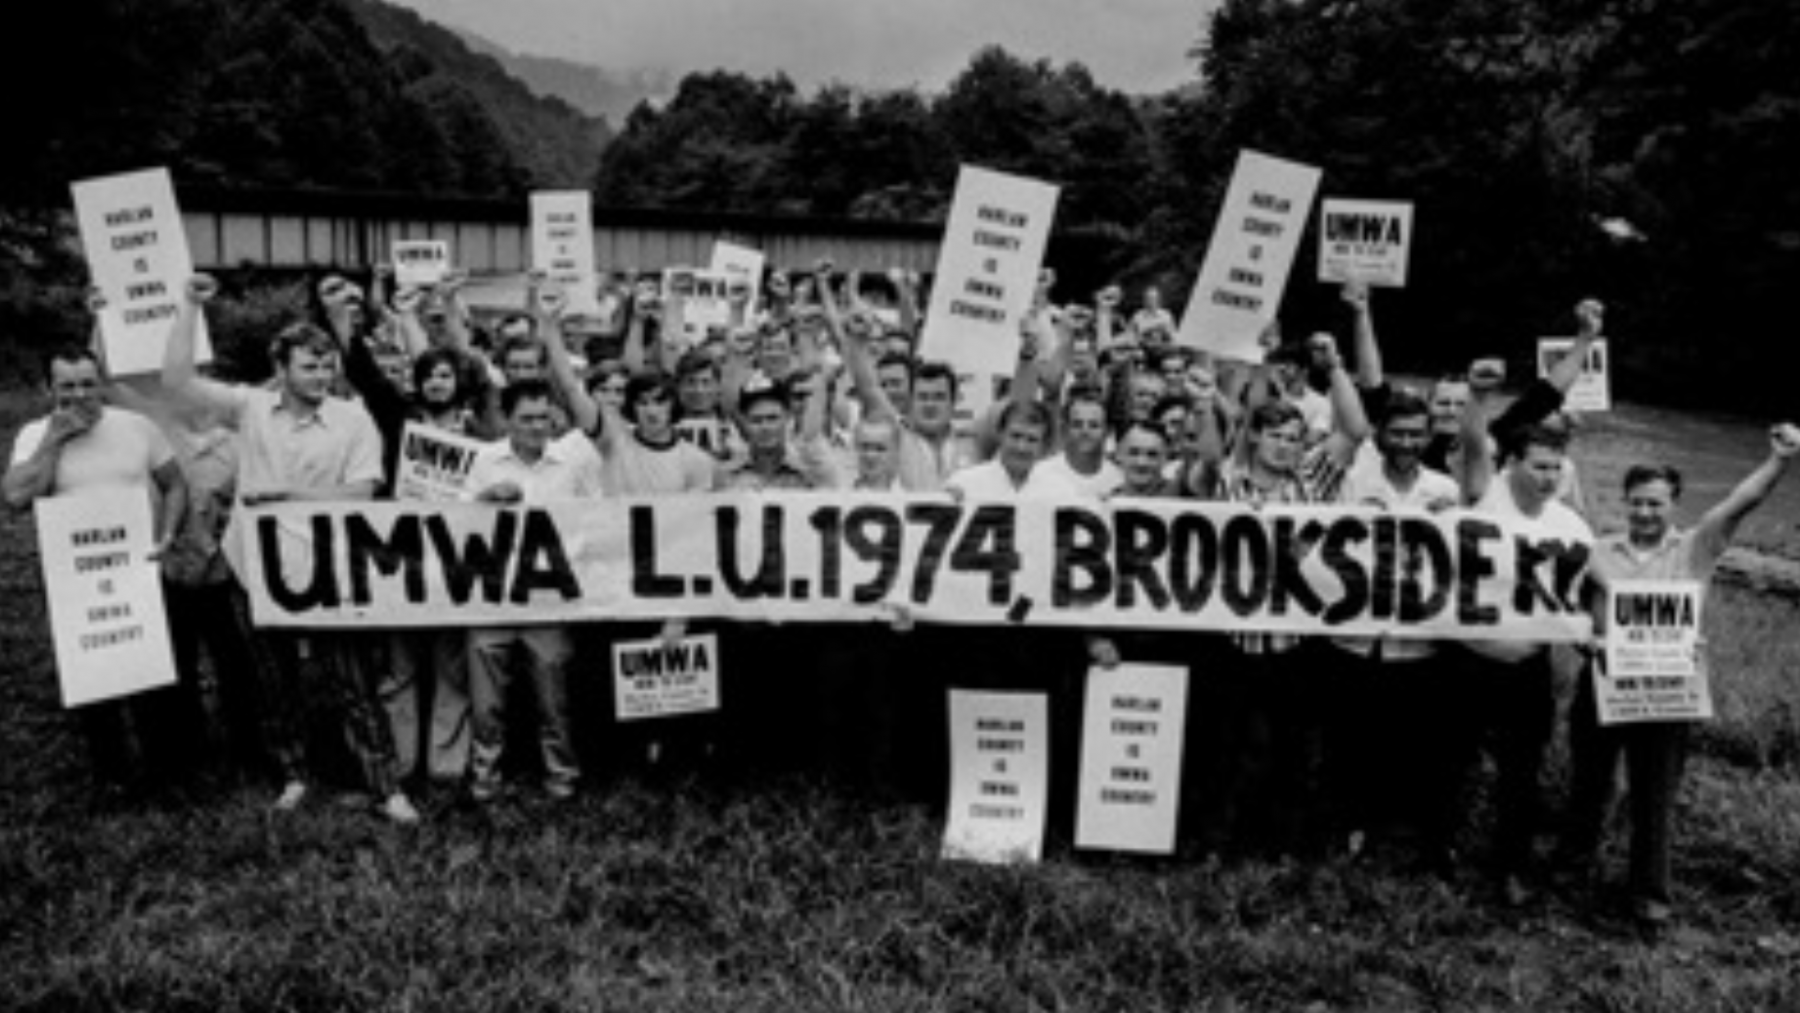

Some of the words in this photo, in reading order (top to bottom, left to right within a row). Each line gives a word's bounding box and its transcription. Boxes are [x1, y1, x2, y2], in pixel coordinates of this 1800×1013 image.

[1327, 212, 1402, 245] UMWA
[74, 552, 129, 574] COUNTY
[257, 508, 583, 613] UMWA
[1052, 506, 1501, 625] BROOKSIDE
[1616, 592, 1694, 626] UMWA
[621, 643, 709, 678] UMWA
